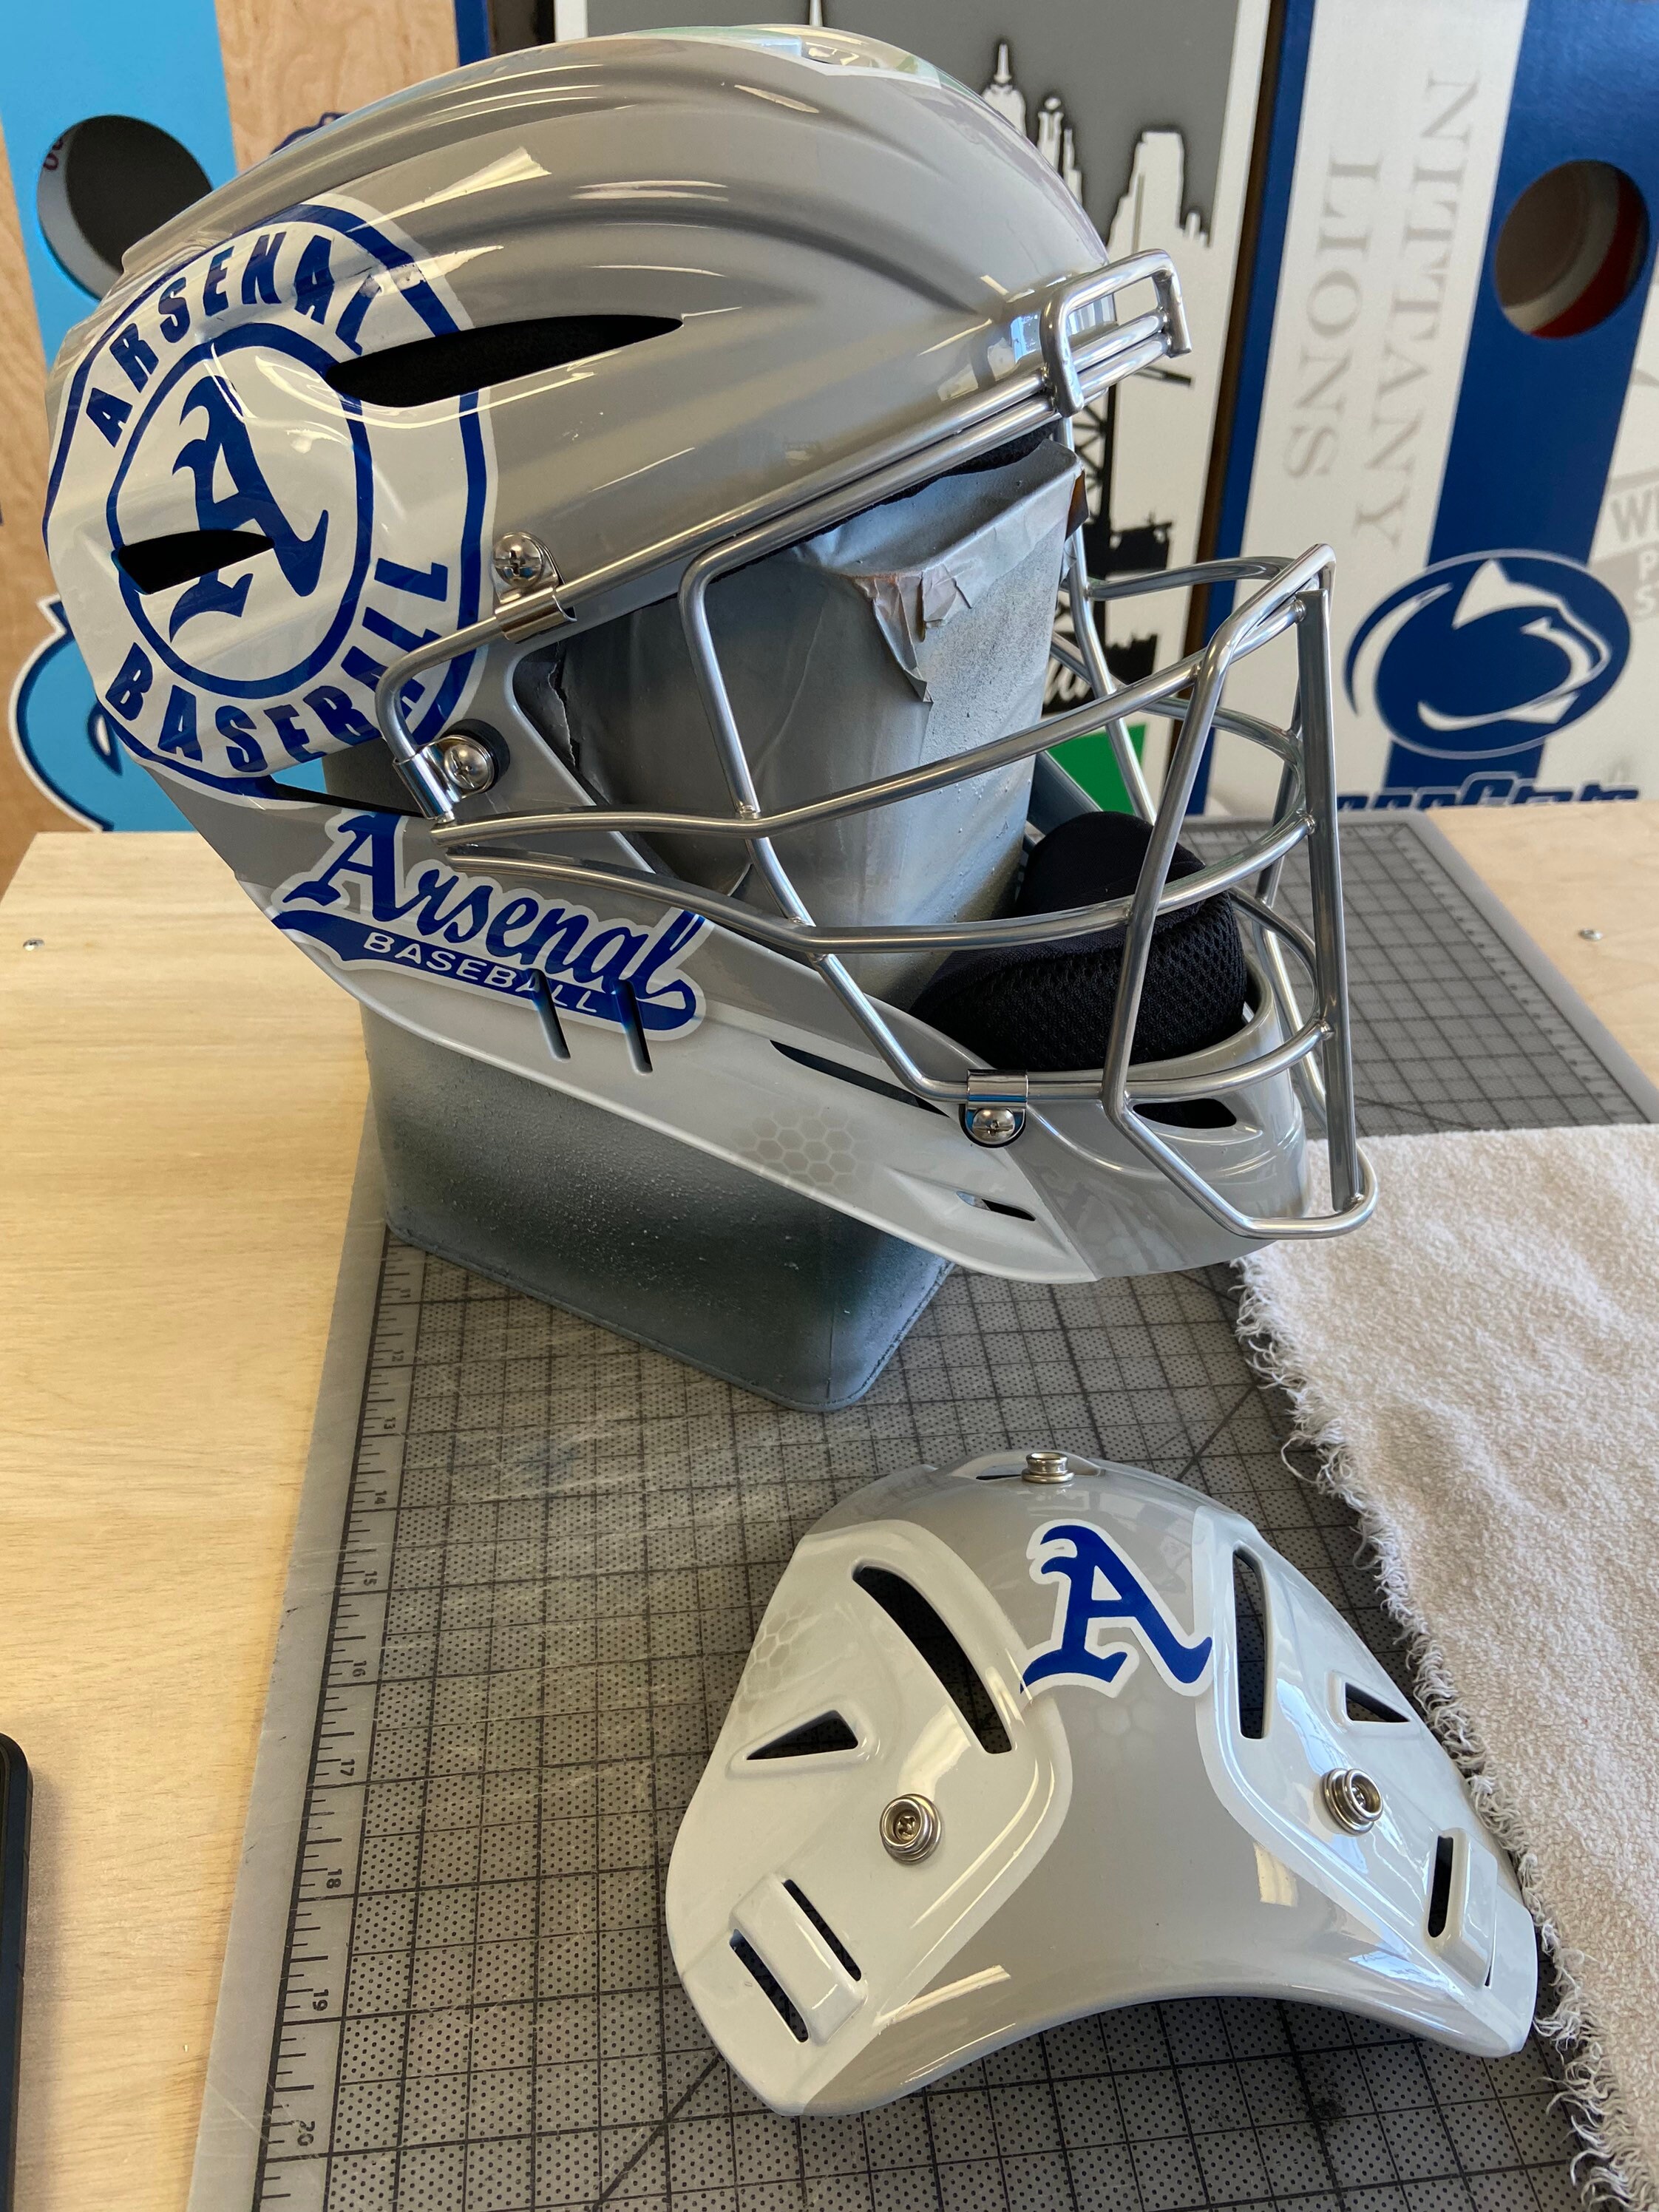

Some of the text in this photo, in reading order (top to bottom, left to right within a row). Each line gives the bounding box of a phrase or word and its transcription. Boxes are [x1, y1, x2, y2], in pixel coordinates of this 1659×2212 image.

[1283, 150, 1384, 481] LIONS
[1353, 70, 1482, 551] NITTANY
[86, 231, 383, 448] ARSENAL
[169, 375, 329, 644] A
[282, 811, 704, 998] Arsenal
[363, 931, 597, 1014] BASEBALL
[391, 1349, 404, 1363] 12
[383, 1417, 396, 1430] 13
[374, 1490, 387, 1504] 14
[363, 1570, 378, 1587] 15
[1020, 1524, 1213, 1695] A
[352, 1660, 367, 1677] 16
[340, 1759, 355, 1776] 17
[326, 1868, 342, 1889] 18
[312, 1988, 329, 2012] 19
[297, 2120, 316, 2147] 20
